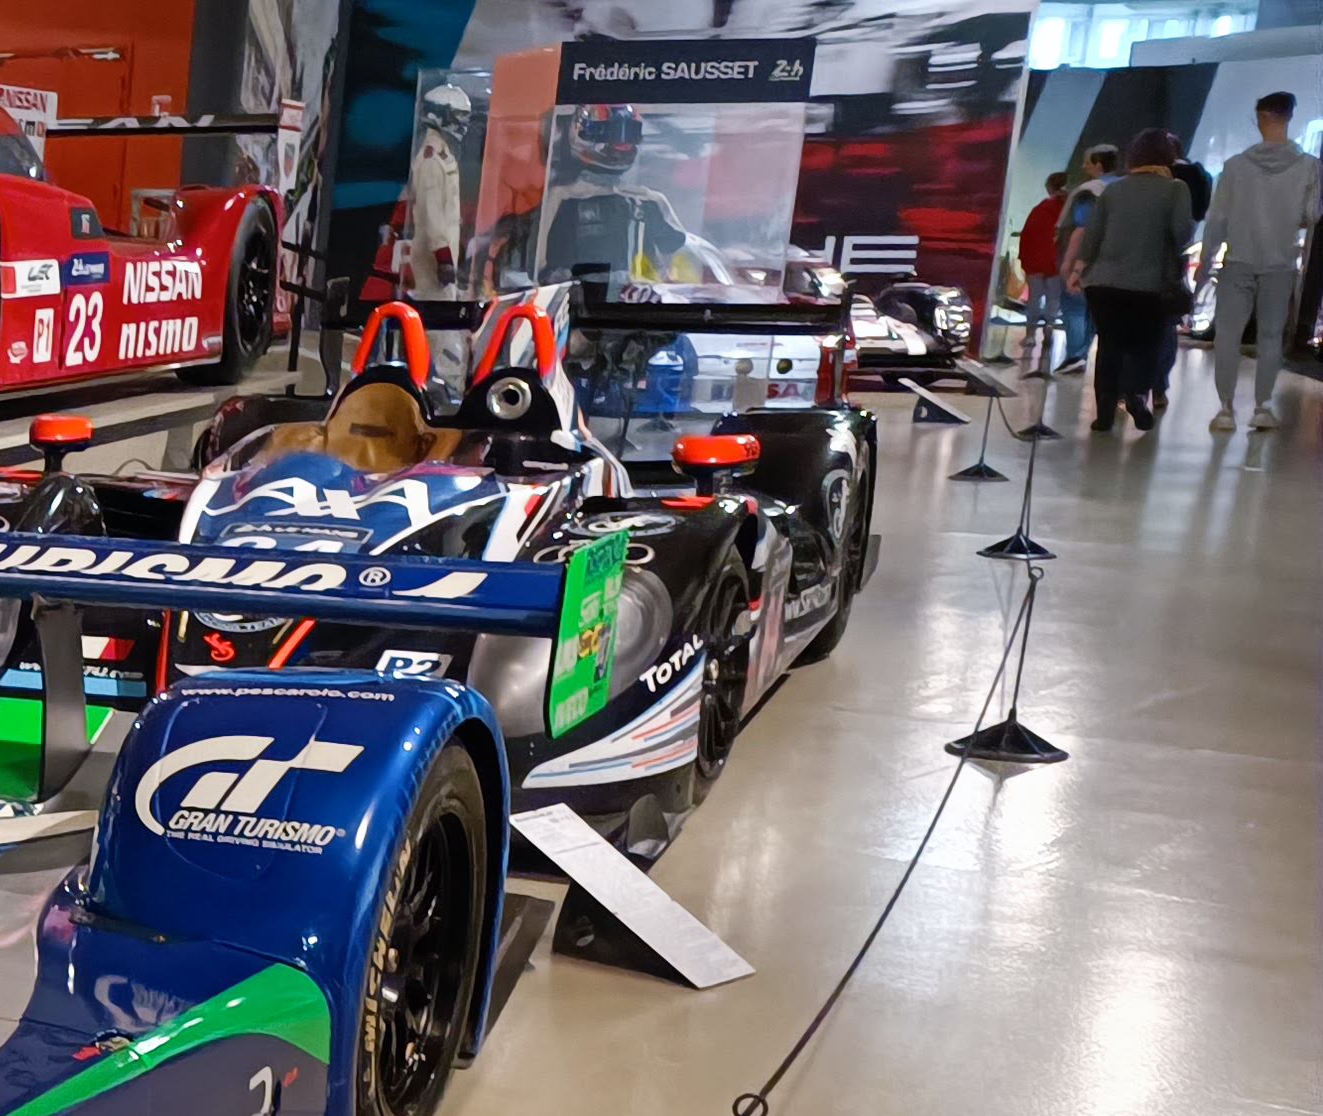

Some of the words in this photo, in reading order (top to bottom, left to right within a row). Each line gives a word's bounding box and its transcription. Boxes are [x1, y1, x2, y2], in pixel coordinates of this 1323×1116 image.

[660, 60, 759, 80] SAUSSET
[123, 259, 203, 305] NISSAN
[65, 291, 104, 367] 23
[639, 634, 704, 692] TOTAL
[168, 810, 233, 834] GRAN
